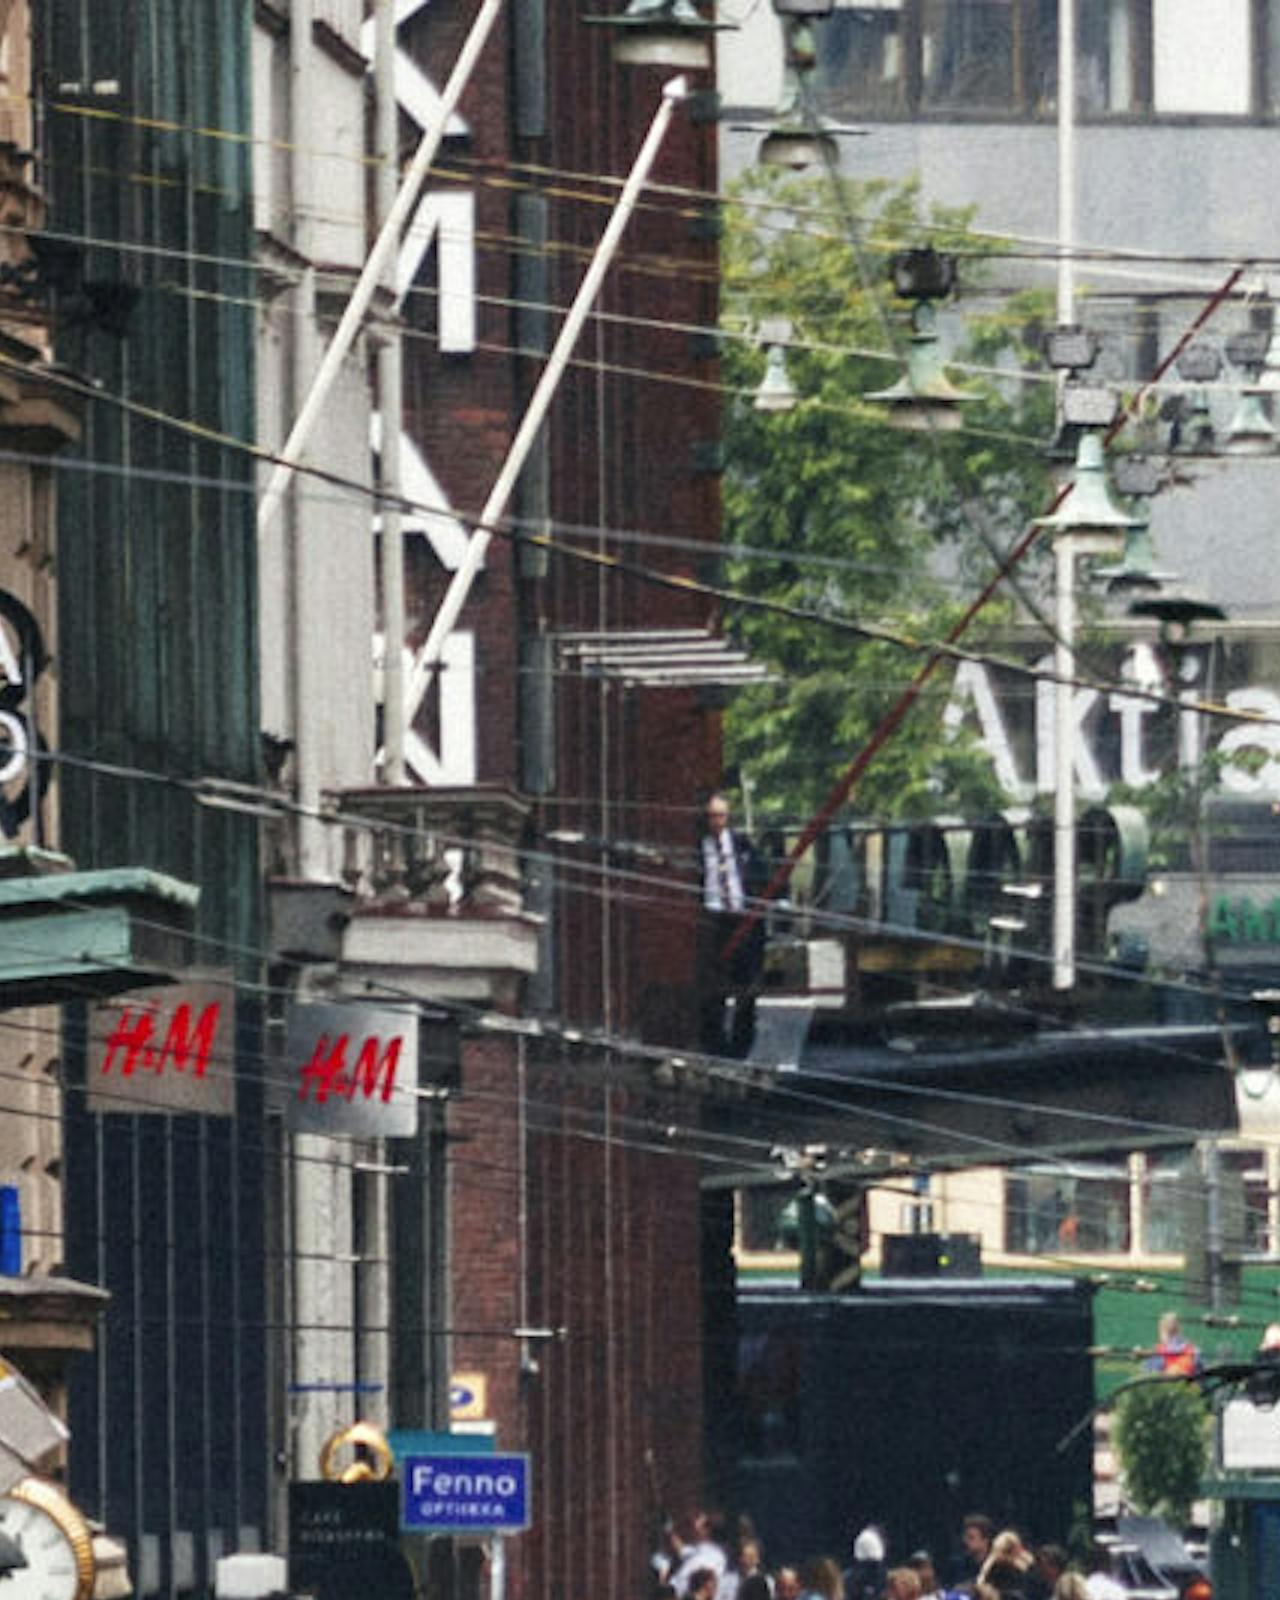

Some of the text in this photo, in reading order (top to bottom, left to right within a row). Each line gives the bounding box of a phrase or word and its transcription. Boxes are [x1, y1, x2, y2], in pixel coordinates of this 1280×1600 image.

[102, 998, 221, 1079] H&M
[297, 1031, 403, 1104] H&M
[412, 1465, 517, 1497] Fenno
